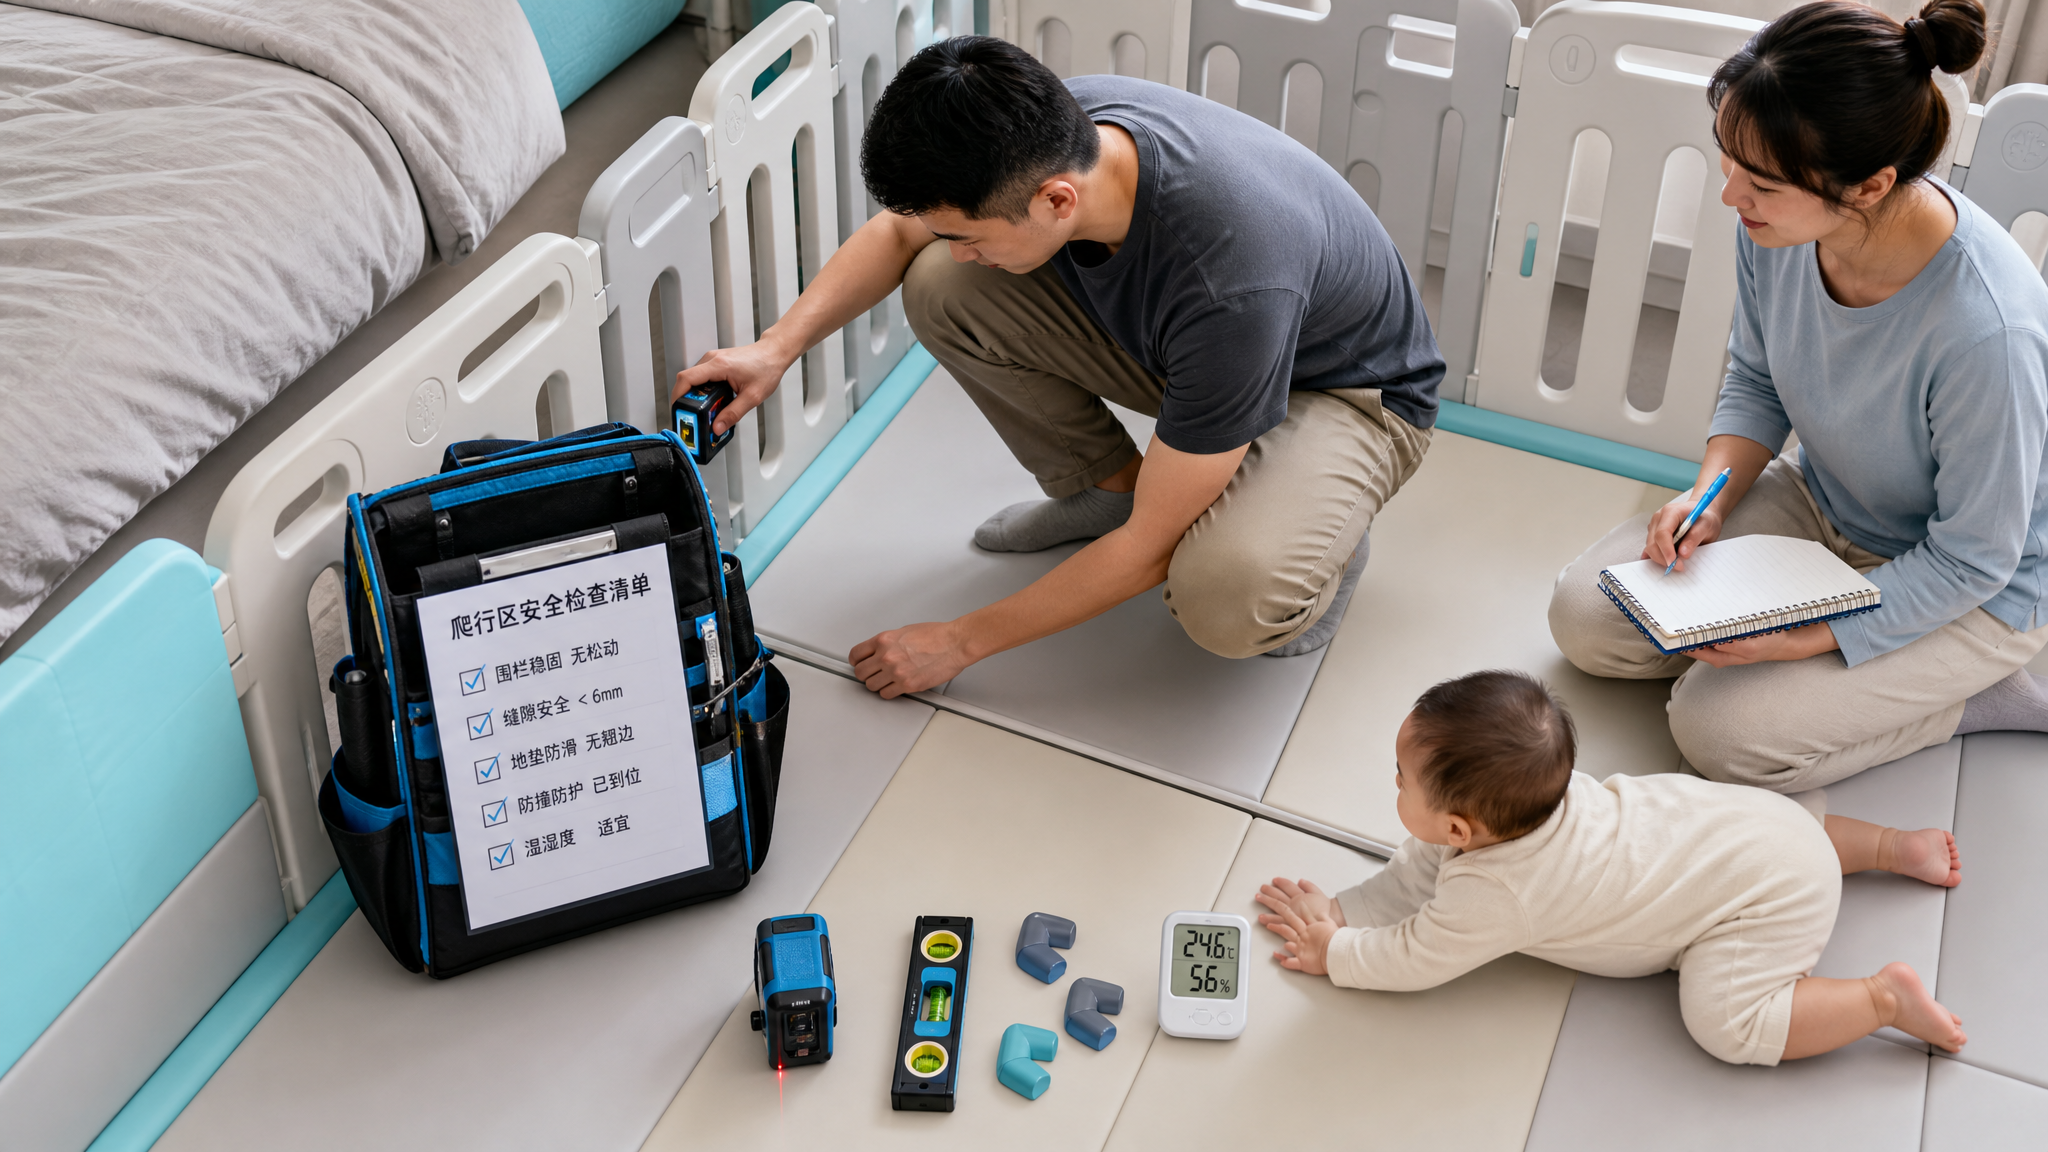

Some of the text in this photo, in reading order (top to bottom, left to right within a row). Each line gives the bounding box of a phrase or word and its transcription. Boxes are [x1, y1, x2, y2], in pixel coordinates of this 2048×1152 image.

[451, 572, 652, 641] 爬行区安全检查清单
[495, 638, 619, 684] 围栏稳固 无松动
[503, 695, 571, 727] 缝隙安全
[510, 738, 577, 770] 地垫防滑
[518, 766, 642, 815] 防撞防护 已到位
[524, 814, 631, 858] 温湿度 适宜
